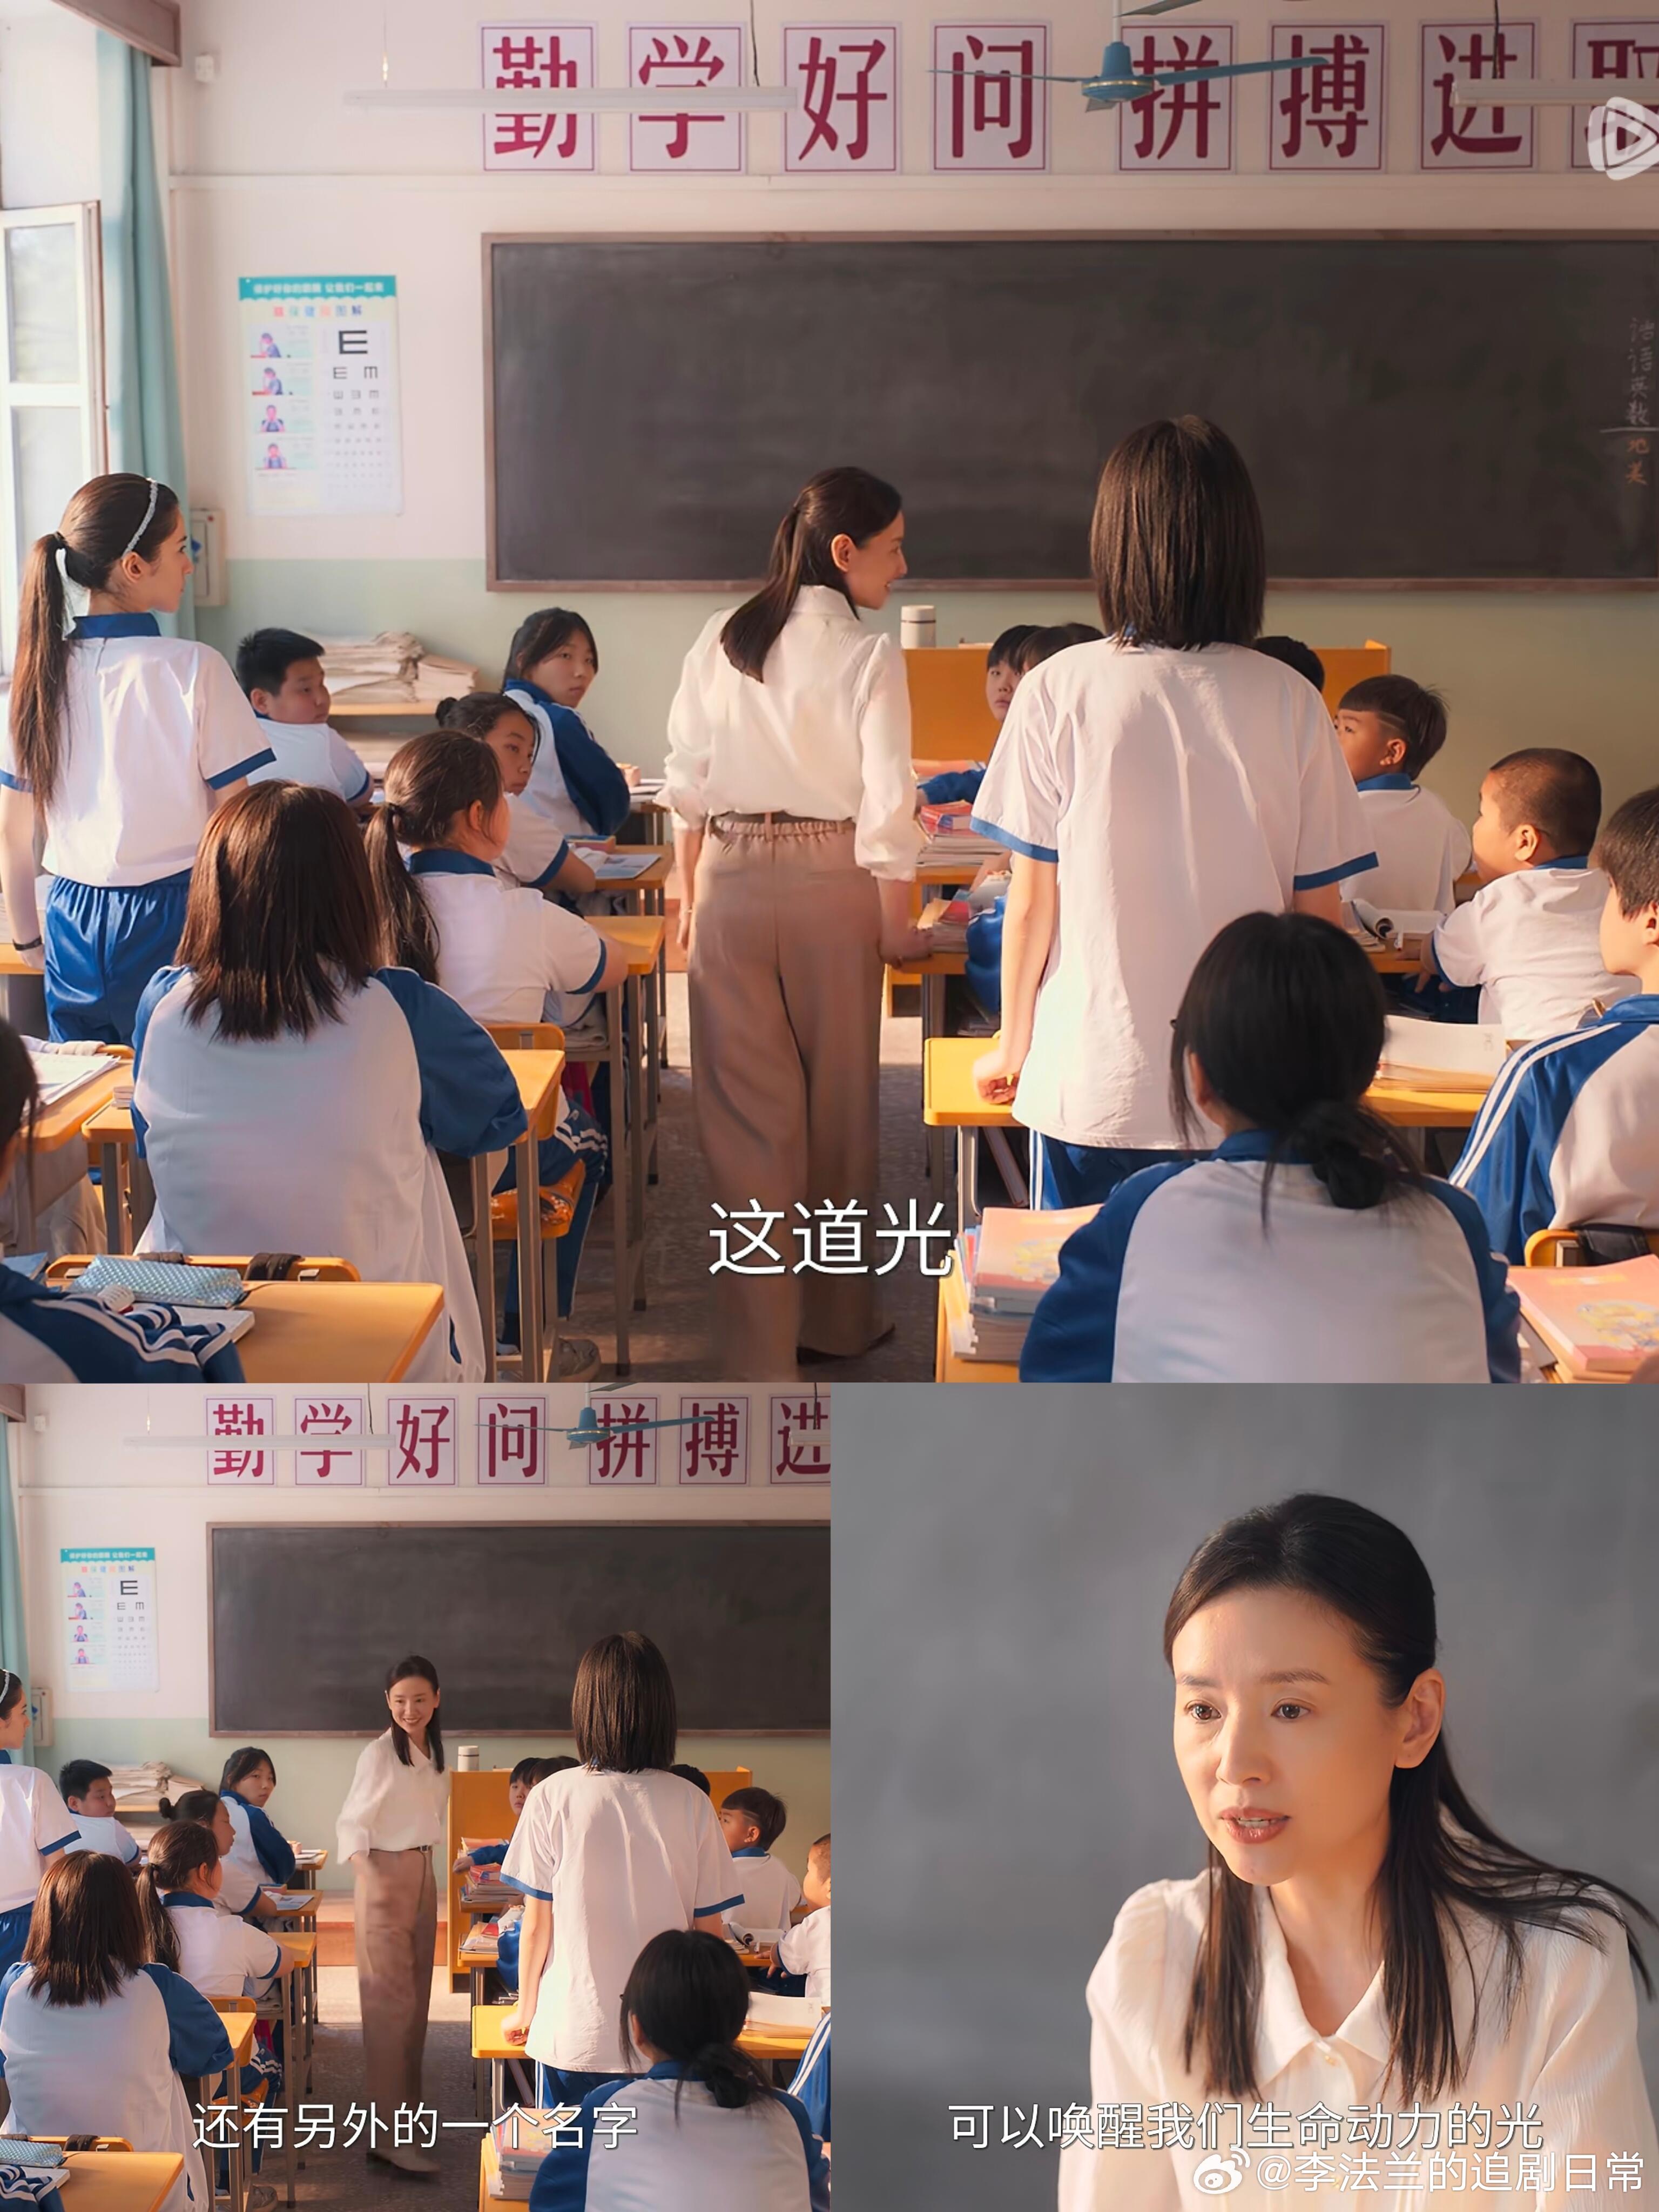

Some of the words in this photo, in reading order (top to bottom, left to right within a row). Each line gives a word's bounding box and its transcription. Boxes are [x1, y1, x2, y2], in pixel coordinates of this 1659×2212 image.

[493, 35, 1033, 160] 勤学好问
[213, 1403, 537, 1479] 勤学好问
